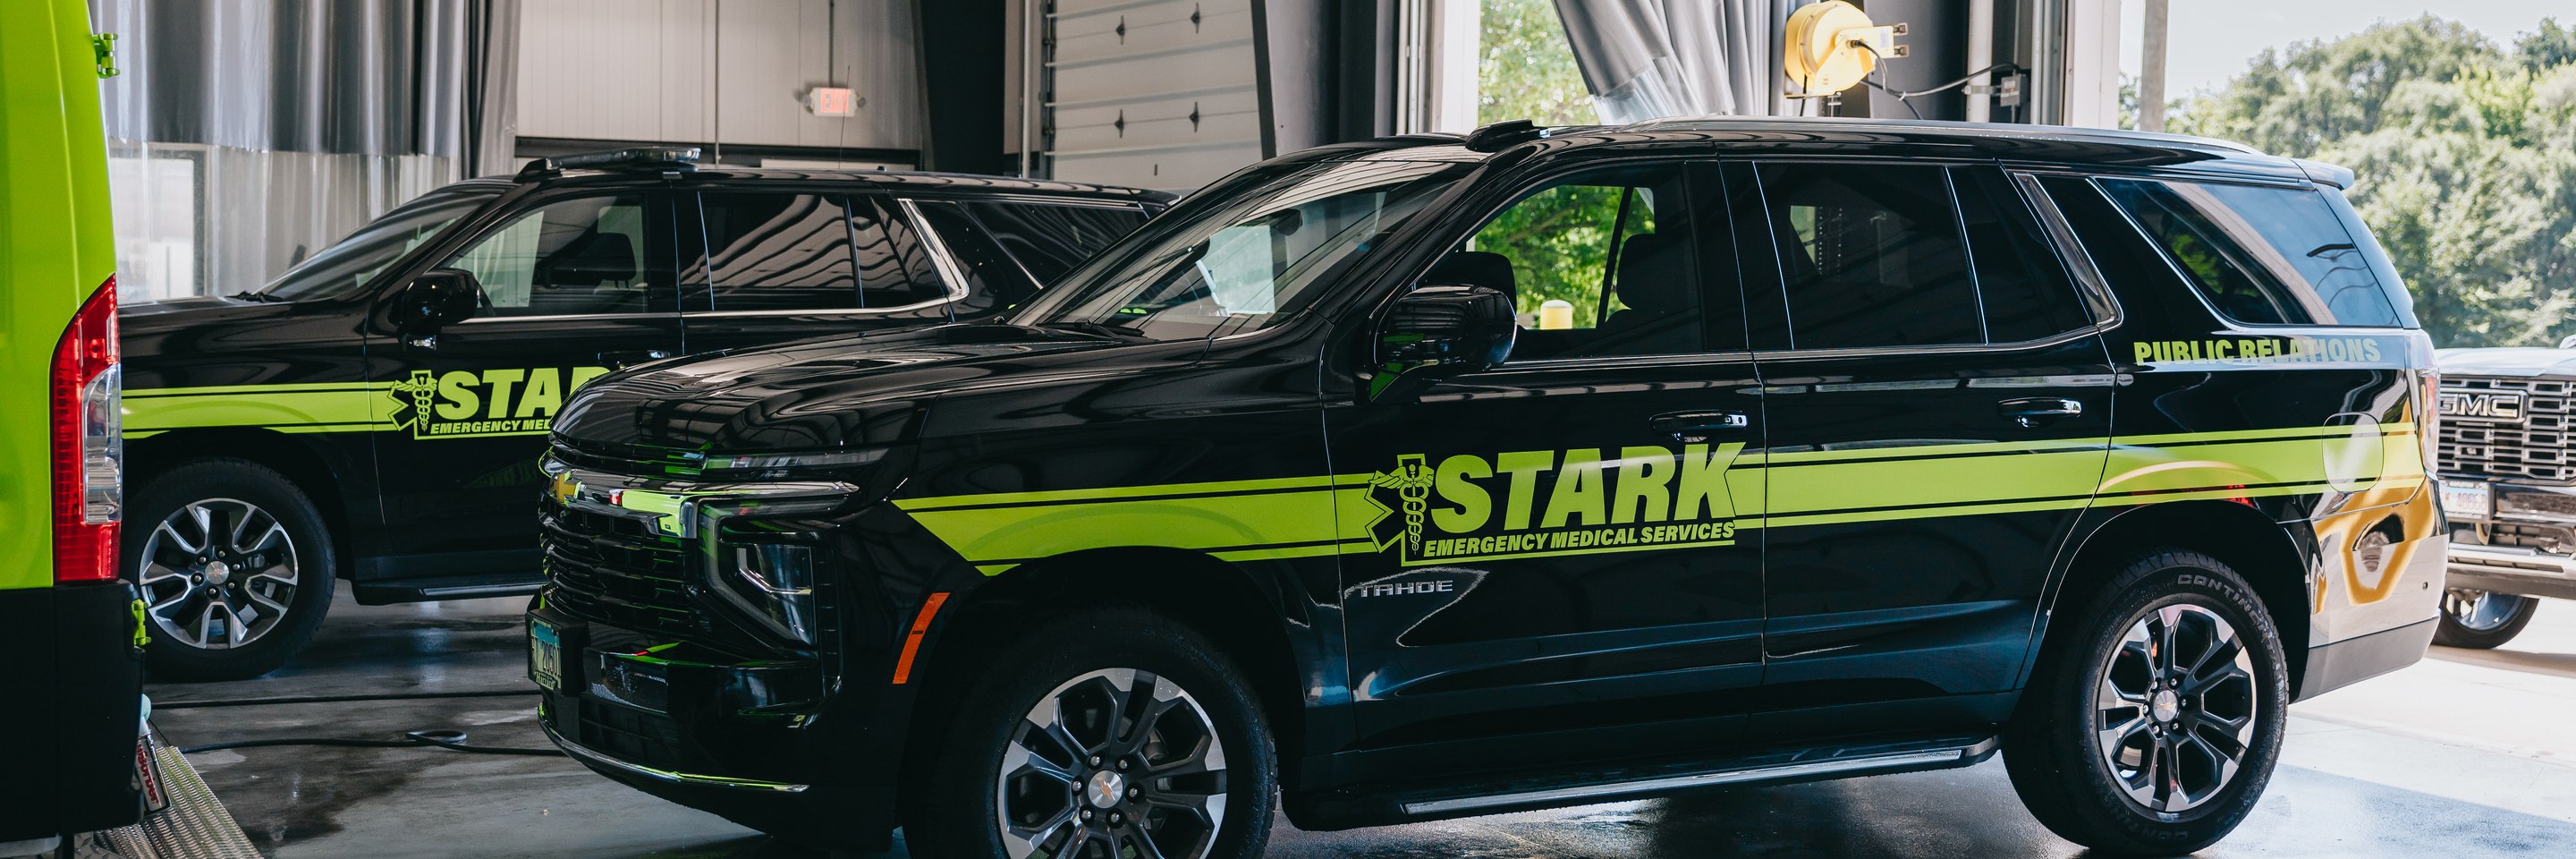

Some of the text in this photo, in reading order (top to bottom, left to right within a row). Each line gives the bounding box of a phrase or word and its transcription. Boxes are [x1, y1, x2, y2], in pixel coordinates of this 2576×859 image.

[2134, 338, 2381, 366] PUBLIC RELATIONS
[430, 421, 521, 435] EMERGENCY
[1431, 442, 1746, 533] STARK
[1424, 523, 1735, 557] EMERGENCY MEDICAL SERVICES
[1359, 580, 1453, 598] TAHOE
